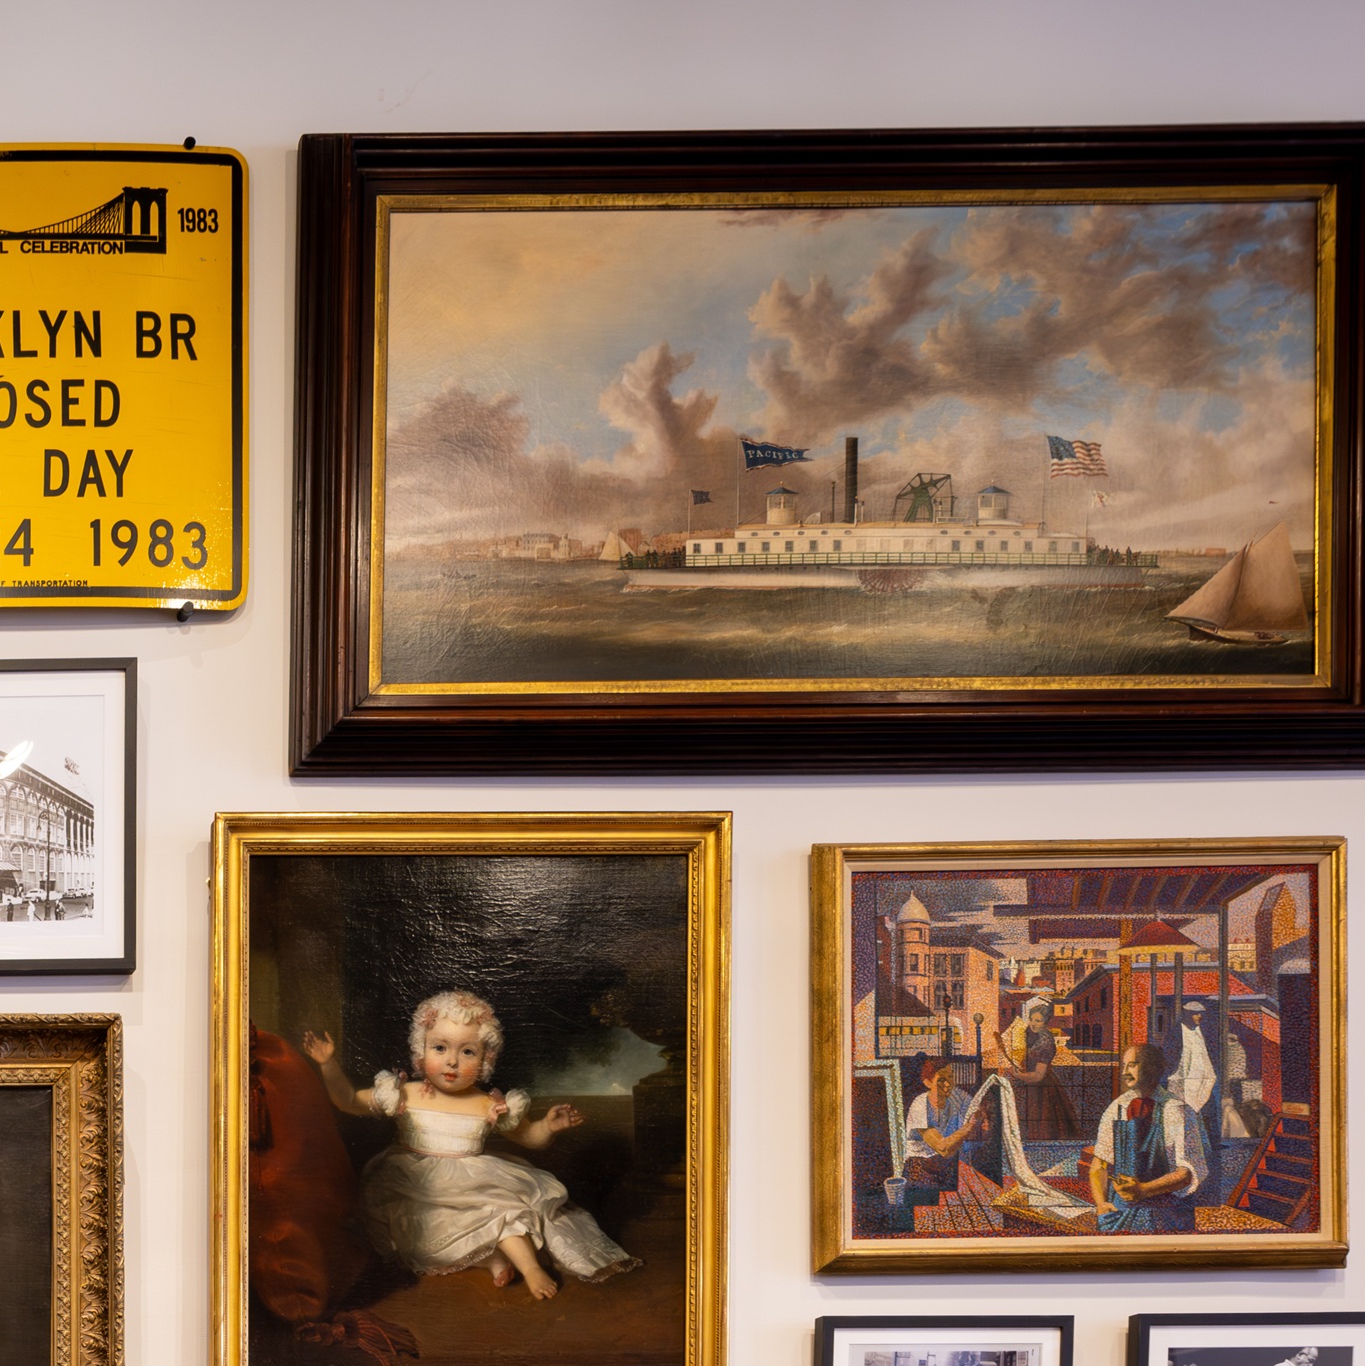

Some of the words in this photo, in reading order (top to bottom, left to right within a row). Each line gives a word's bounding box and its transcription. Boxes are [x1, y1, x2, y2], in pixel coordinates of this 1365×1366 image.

[177, 207, 219, 234] 1983
[20, 239, 123, 256] CELEBRATION
[135, 310, 198, 361] BR
[746, 449, 799, 460] PACIFIC
[43, 448, 134, 498] DAY
[89, 518, 209, 570] 1983
[12, 579, 88, 587] TRANSPORTATION
